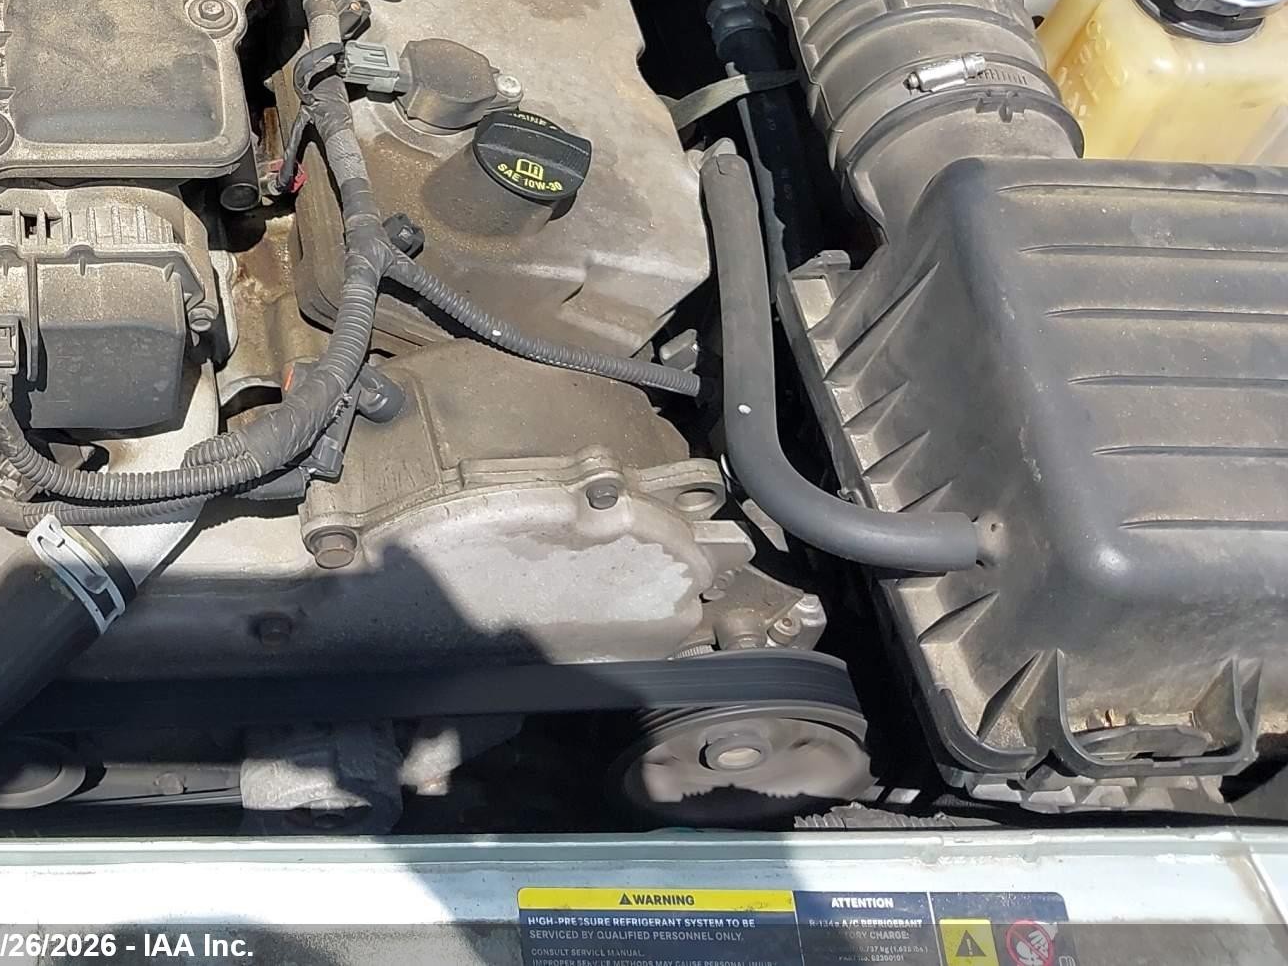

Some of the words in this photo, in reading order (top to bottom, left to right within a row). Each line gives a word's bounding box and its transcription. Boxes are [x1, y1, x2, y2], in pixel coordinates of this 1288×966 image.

[497, 163, 521, 182] SAE
[523, 178, 563, 192] 10W-30
[633, 894, 695, 906] WARNING
[831, 897, 894, 909] ATTENTION
[612, 917, 682, 928] REFRIGERANT
[684, 918, 725, 928] SYSTEM
[726, 918, 740, 928] TO
[742, 918, 756, 928] BE
[841, 919, 859, 929] A/C
[860, 919, 923, 929] REFRIGERANT
[529, 929, 579, 939] SERVICED
[581, 930, 594, 939] BY
[596, 930, 651, 940] QUALIFIED
[652, 932, 714, 941] PERSONNEL
[715, 932, 745, 942] ONLY.
[869, 930, 910, 940] CHARGE:
[531, 948, 569, 957] CONSULT
[570, 948, 605, 957] SERVICE
